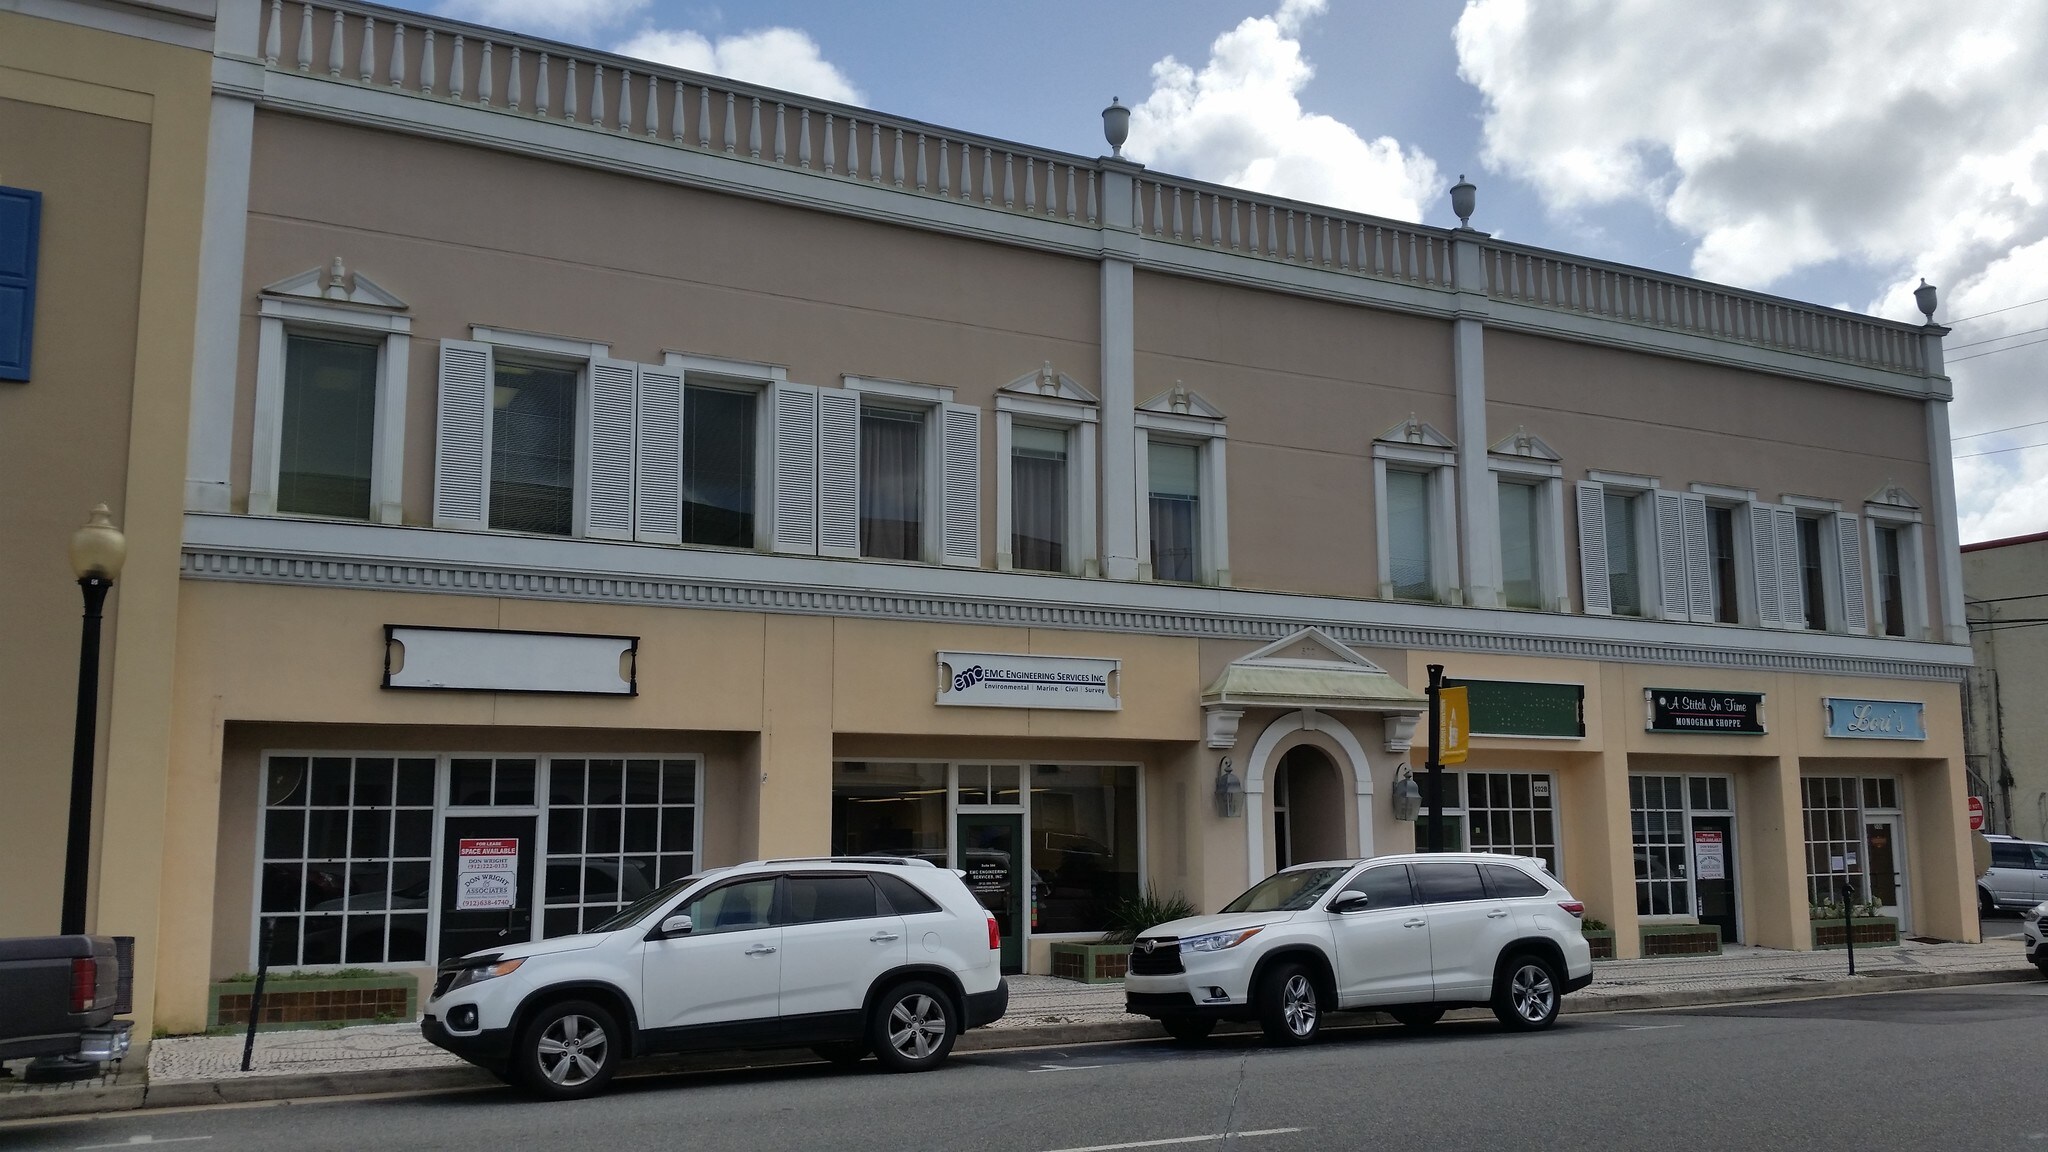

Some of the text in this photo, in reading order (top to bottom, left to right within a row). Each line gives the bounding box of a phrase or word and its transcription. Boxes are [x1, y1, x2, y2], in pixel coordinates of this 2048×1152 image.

[984, 669, 1106, 683] EMC ENGINEERING SERVICES INC.
[984, 683, 1030, 691] Environmental
[1667, 697, 1747, 712] A Stitch In Time
[1676, 717, 1741, 728] MONOGRAM SHOPPE
[1847, 704, 1904, 732] Lori's
[482, 847, 516, 855] AVAILABLE
[464, 874, 510, 887] DON WRIGHT
[466, 887, 508, 895] ASSOCIATES
